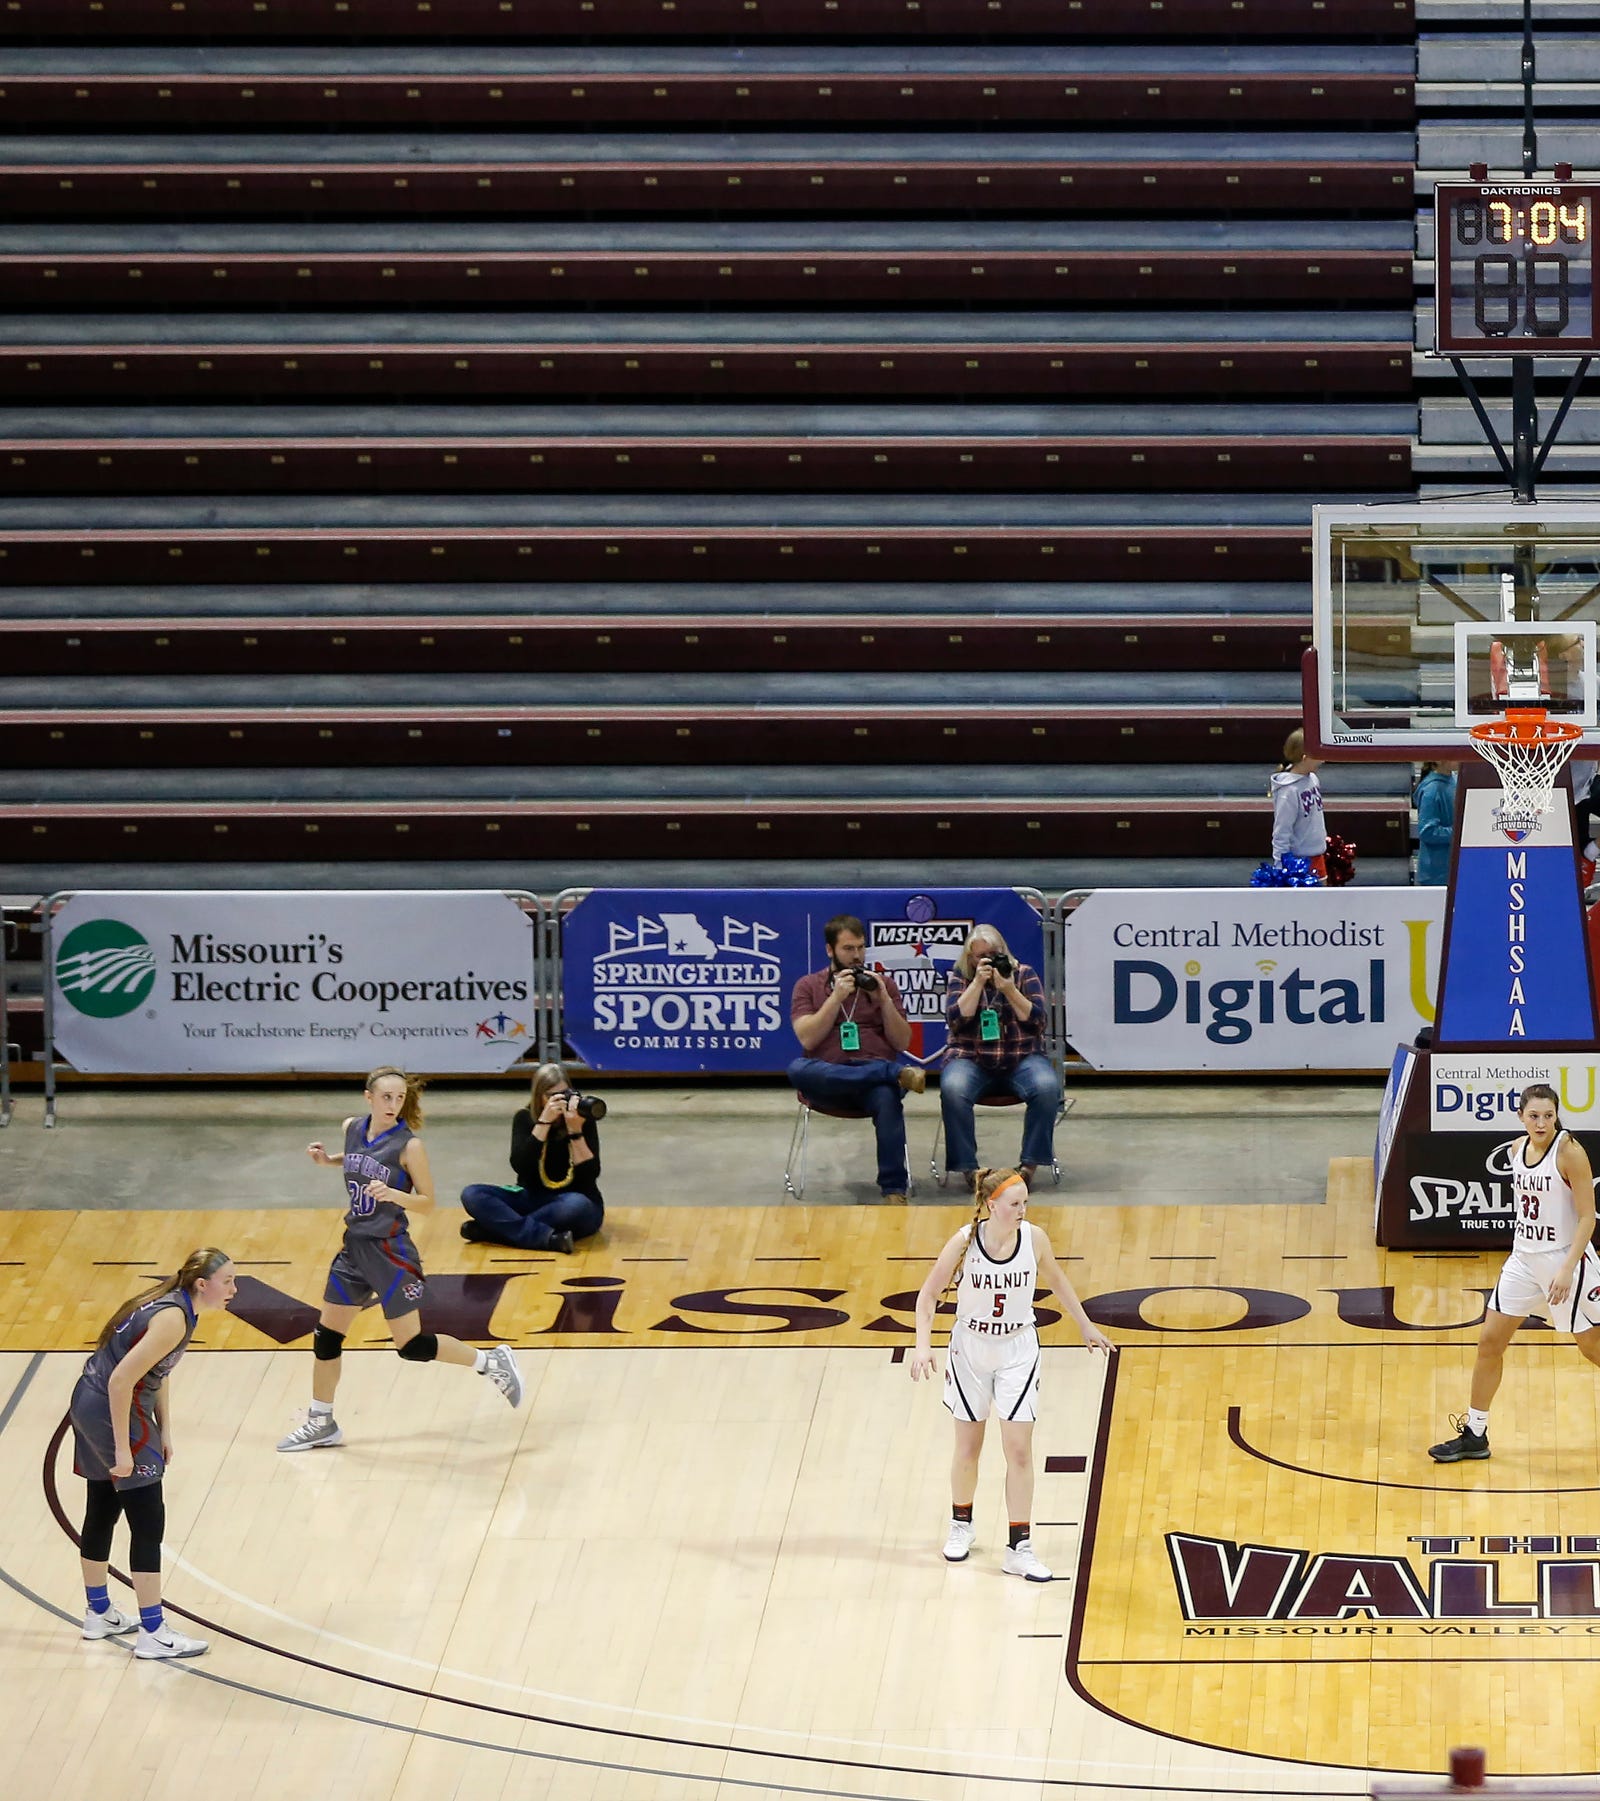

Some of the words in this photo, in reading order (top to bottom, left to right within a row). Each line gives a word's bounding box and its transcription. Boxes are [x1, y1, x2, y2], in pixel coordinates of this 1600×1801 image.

[1480, 187, 1561, 196] DAKTRONICS
[1489, 201, 1588, 245] 7:04
[1333, 734, 1374, 745] SPALDING
[877, 926, 964, 943] MSHSAA
[1113, 921, 1219, 947] Central
[1233, 920, 1385, 947] Methodist
[1506, 851, 1527, 1037] MSHSAA
[171, 934, 343, 964] Missouri's
[593, 963, 781, 986] SPRINGFIELD
[171, 971, 300, 1001] Electric
[312, 971, 527, 1012] Cooperatives
[1113, 959, 1385, 1044] Digital
[593, 994, 781, 1031] SPORTS
[183, 1022, 216, 1038] Your
[222, 1022, 305, 1038] Touchstone
[370, 1022, 469, 1040] Cooperatives
[613, 1035, 762, 1049] COMMISSION
[1436, 1067, 1481, 1079] Central
[1485, 1066, 1550, 1079] Methodist
[1436, 1083, 1535, 1121] Digit
[1515, 1175, 1552, 1192] ALNUT
[348, 1180, 376, 1216] 20
[1520, 1194, 1540, 1220] 33
[1461, 1219, 1488, 1229] TRUE
[1491, 1219, 1505, 1229] TO
[971, 1271, 1030, 1289] WALNUT
[992, 1294, 1007, 1318] 5
[1185, 1626, 1395, 1636] MISSOURI
[1419, 1626, 1568, 1636] VALLEY
